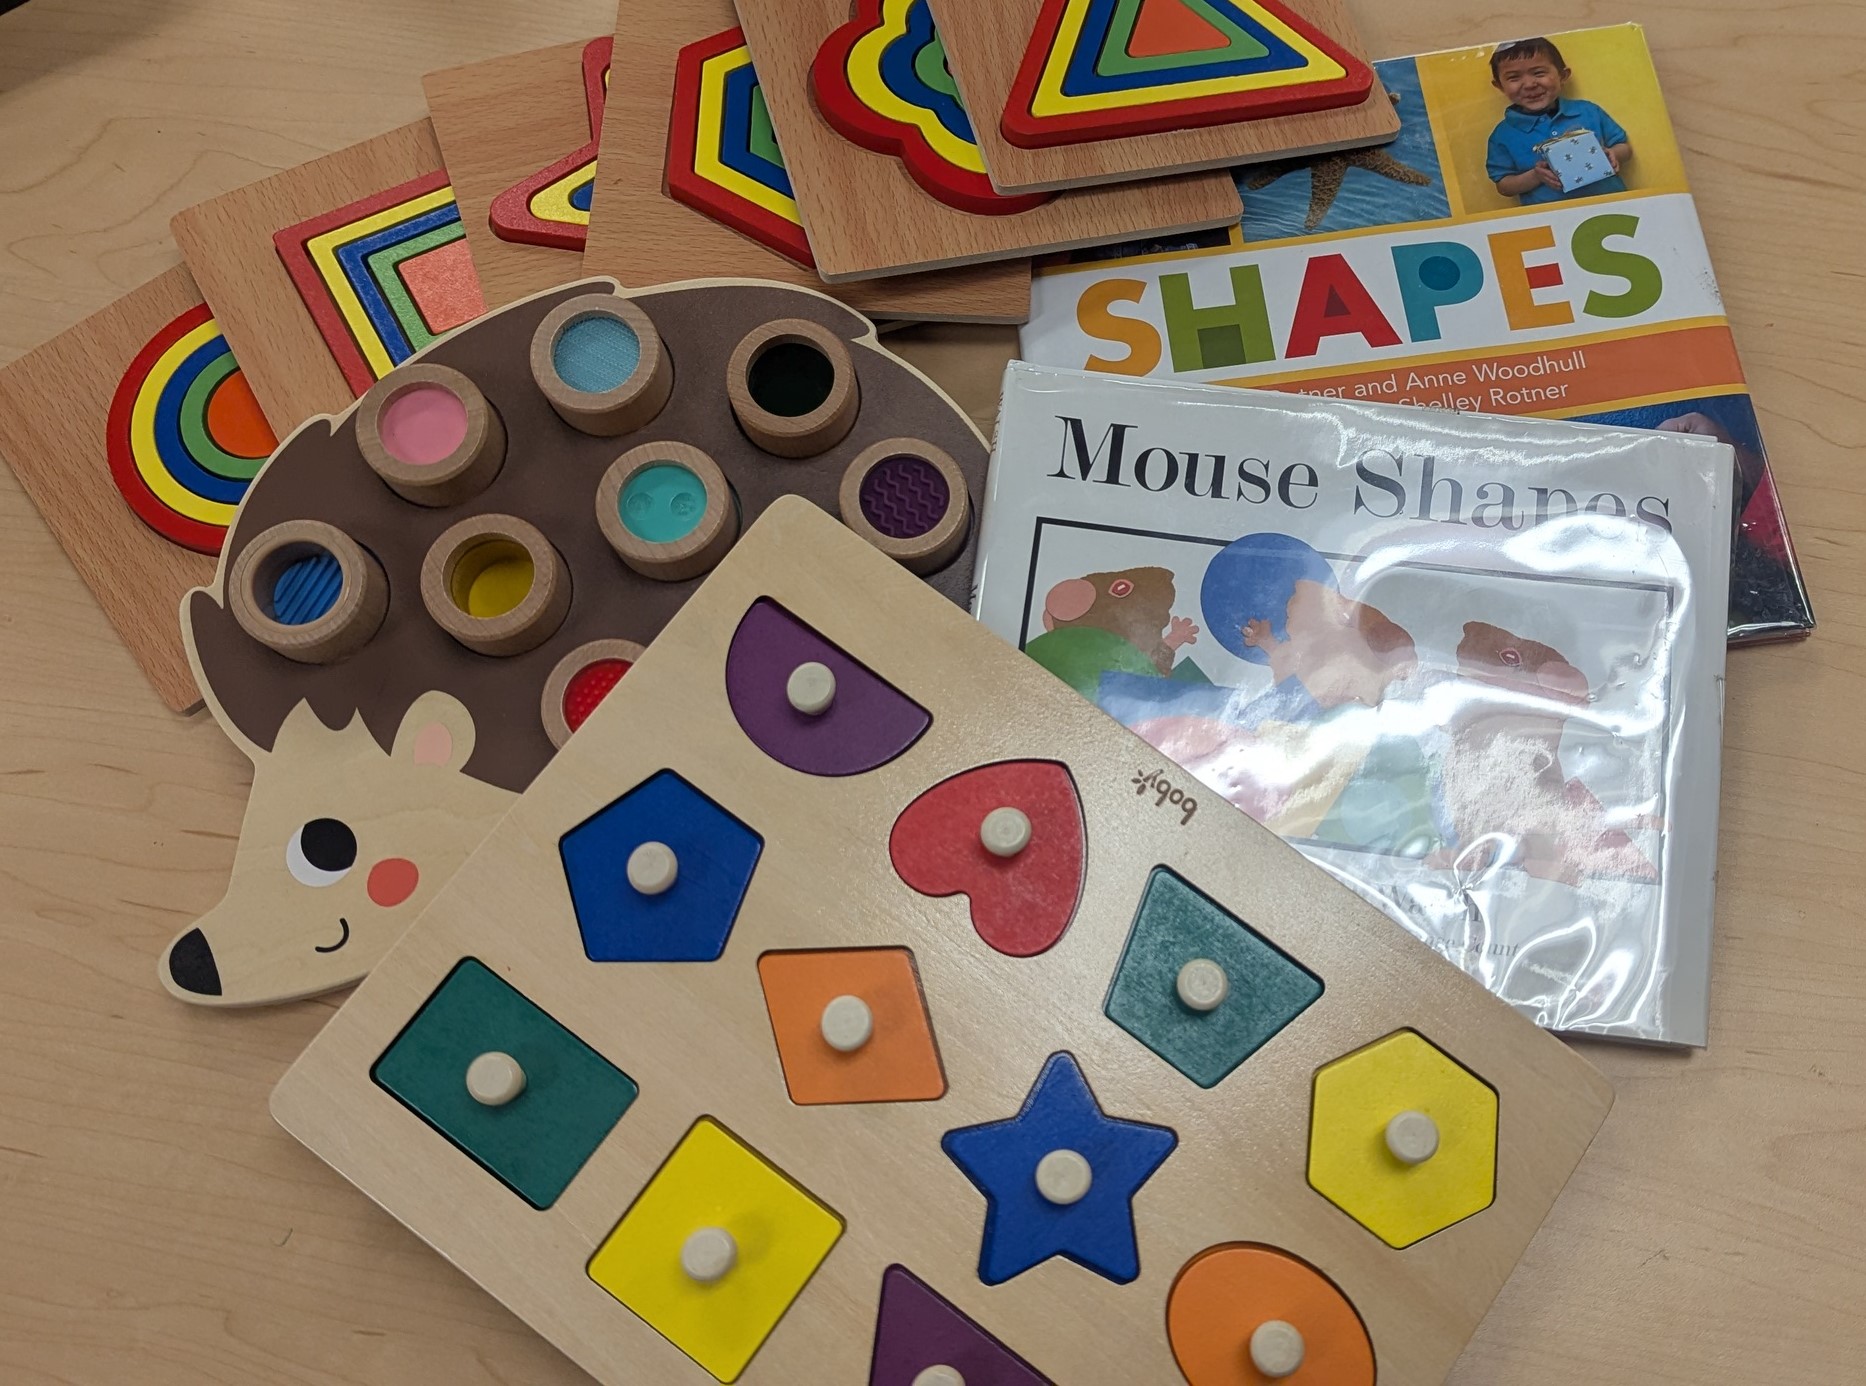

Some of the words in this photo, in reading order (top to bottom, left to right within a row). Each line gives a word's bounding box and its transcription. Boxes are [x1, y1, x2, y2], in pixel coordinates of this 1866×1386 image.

[1075, 213, 1664, 378] SHAPES
[1354, 377, 1398, 397] and
[1405, 371, 1467, 392] Anne
[1471, 349, 1587, 382] Woodhull
[1489, 381, 1570, 407] Rotner
[1046, 414, 1320, 510] Mouse
